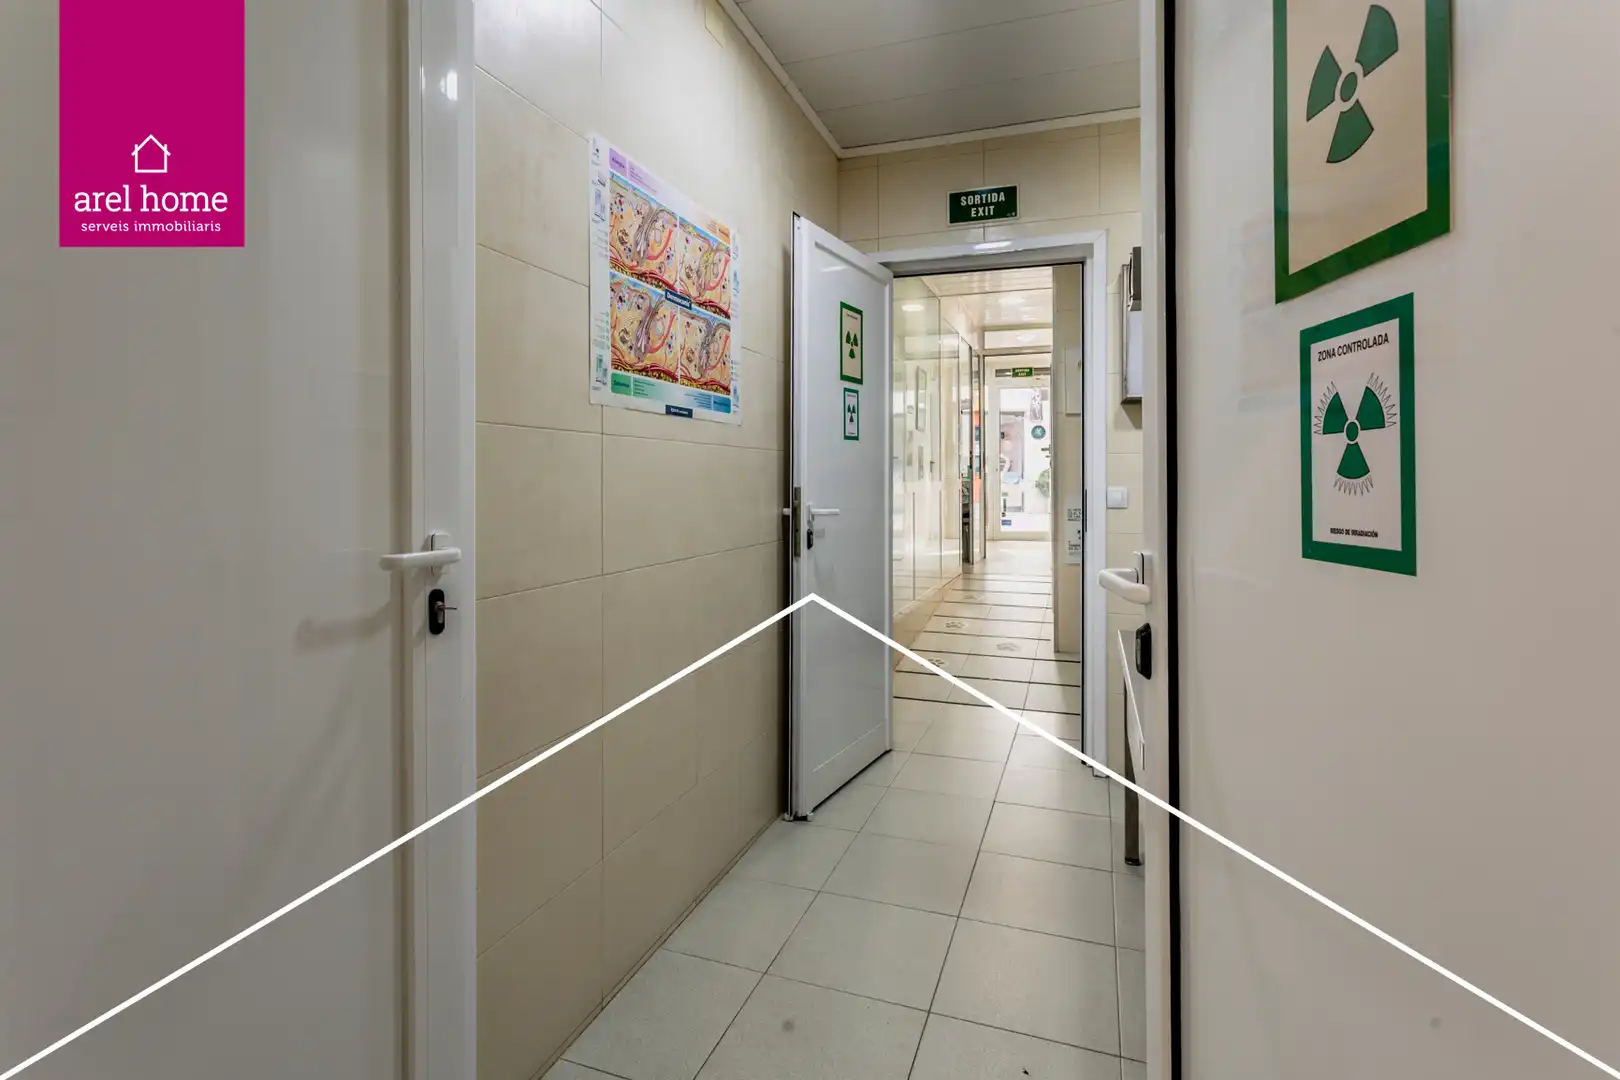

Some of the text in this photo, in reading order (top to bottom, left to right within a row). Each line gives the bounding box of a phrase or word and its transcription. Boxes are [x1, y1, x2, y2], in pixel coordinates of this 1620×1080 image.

[960, 191, 1005, 206] SORTIDA
[971, 205, 995, 217] EXIT
[1317, 332, 1390, 362] ZONA CONTROLADA
